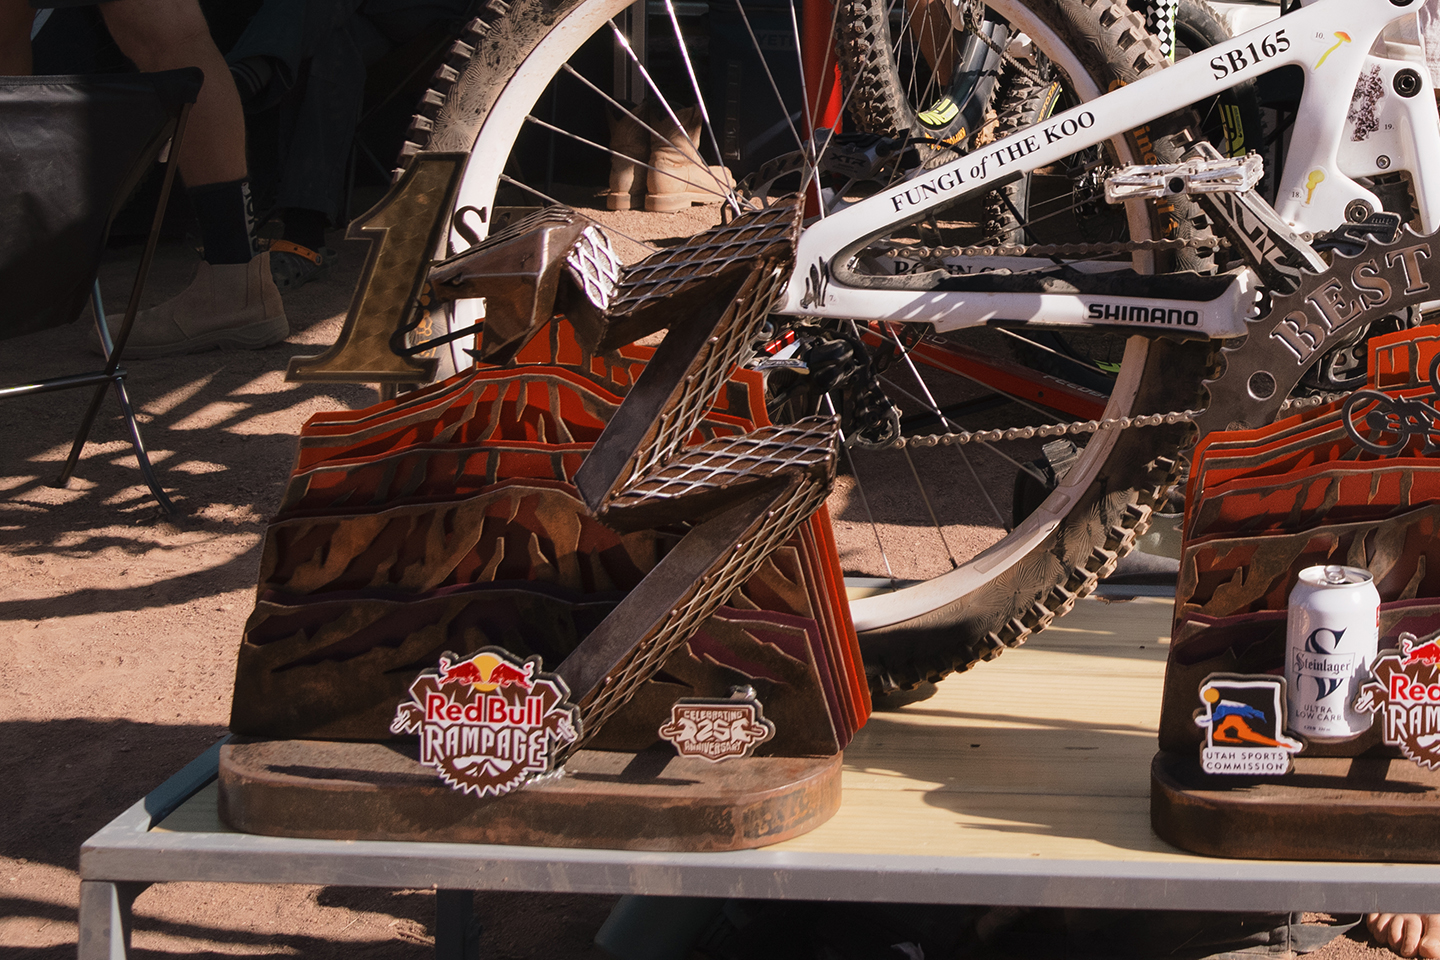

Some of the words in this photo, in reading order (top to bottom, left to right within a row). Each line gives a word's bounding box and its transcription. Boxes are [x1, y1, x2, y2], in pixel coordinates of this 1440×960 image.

[1208, 29, 1292, 81] SB165
[888, 167, 964, 213] FUNGI
[968, 155, 990, 181] of
[991, 135, 1041, 168] THE
[1045, 111, 1096, 146] KOO
[1088, 304, 1199, 326] SHIMANO
[1269, 243, 1431, 366] BEST
[1295, 652, 1351, 675] Steinlager
[427, 694, 483, 723] Red
[488, 694, 542, 725] Bull
[684, 710, 743, 721] CELEBRATING
[1295, 710, 1314, 720] LOW
[1317, 713, 1341, 722] CARB
[1304, 704, 1332, 714] ULTRA
[696, 719, 730, 742] 25
[422, 726, 548, 770] RAMPAGE
[684, 740, 742, 755] ANNIVERSARY
[1206, 751, 1236, 761] UTAH
[1241, 751, 1284, 761] SPORTS
[1206, 762, 1284, 772] COMMISSION
